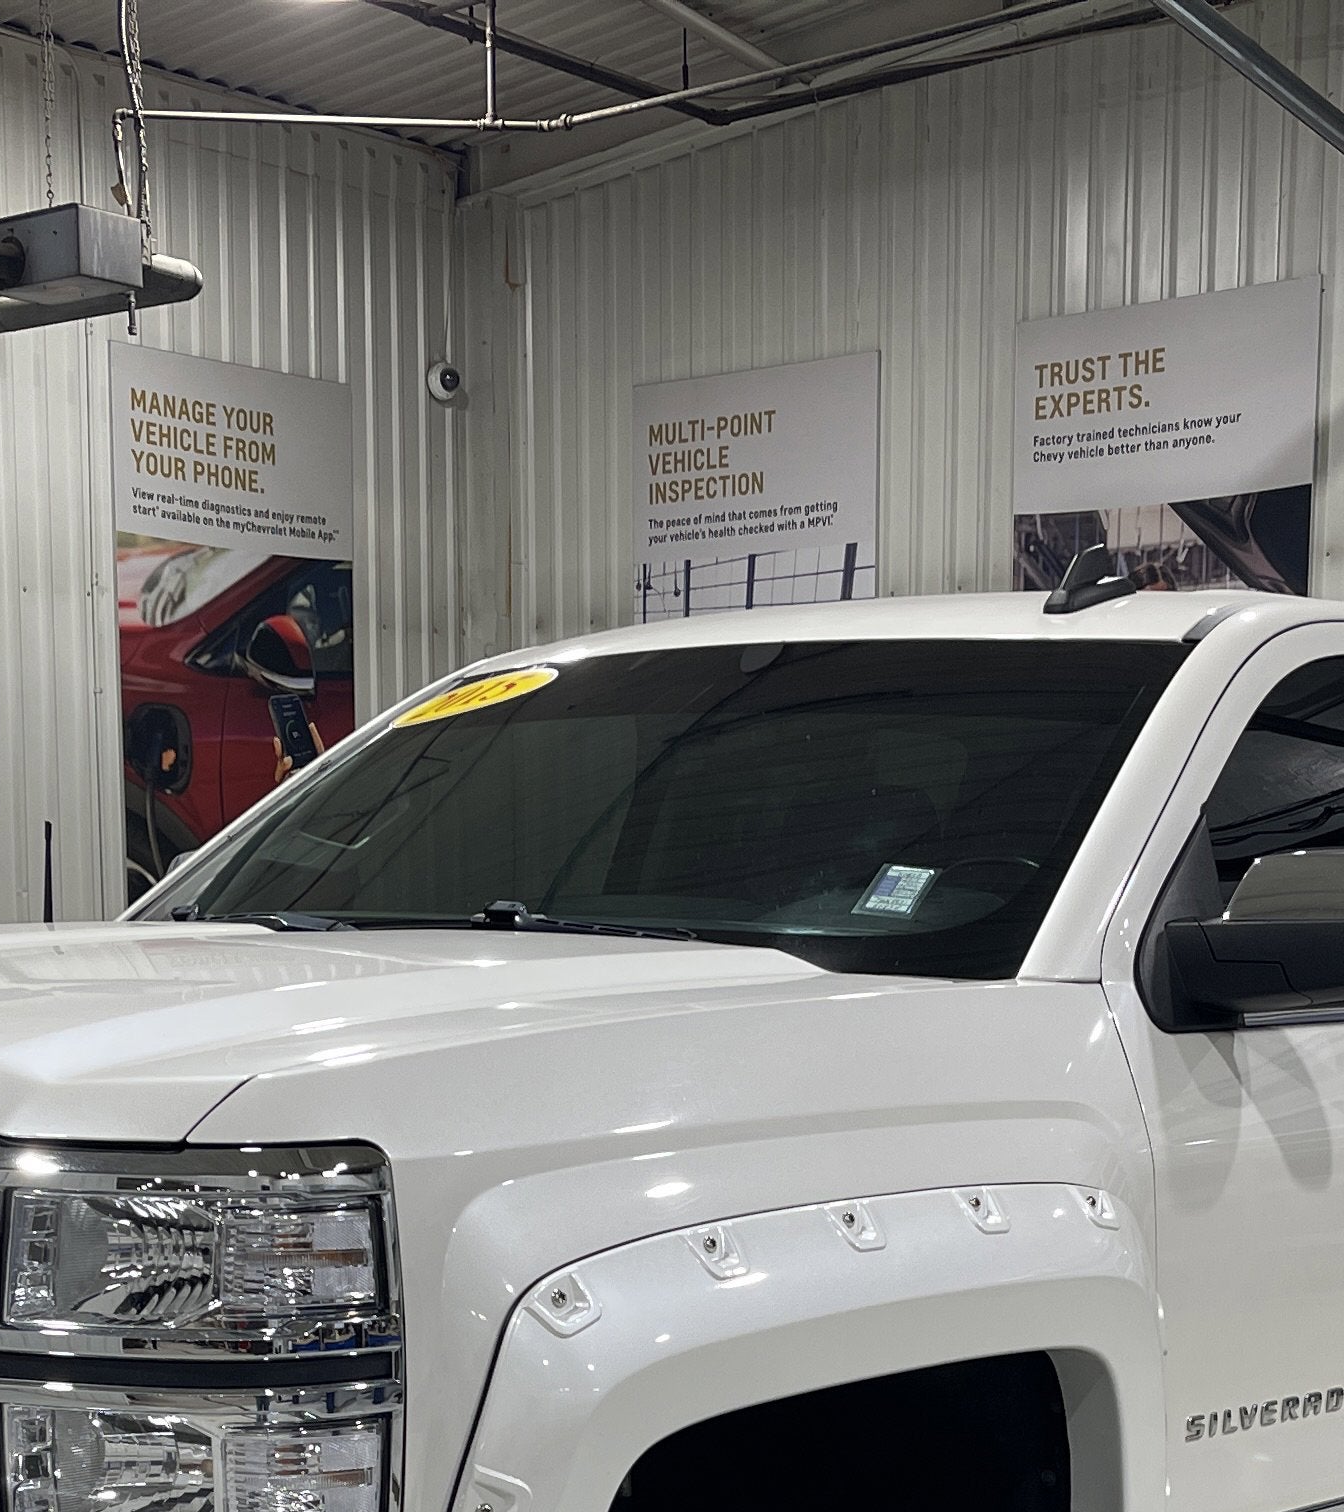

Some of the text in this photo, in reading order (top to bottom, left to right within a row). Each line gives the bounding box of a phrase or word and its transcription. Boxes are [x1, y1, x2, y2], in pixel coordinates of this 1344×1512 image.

[1034, 347, 1166, 389] TRUST THE
[130, 386, 274, 436] MANAGE YOUR
[1034, 383, 1150, 421] EXPERTS.
[130, 418, 276, 466] VEHICLE FROM
[648, 409, 776, 447] MULTI-POINT
[1033, 413, 1241, 447] Factory trained technicians know your
[648, 445, 729, 476] VEHICLE
[1033, 434, 1215, 463] Chevy vehicle better than anyone.
[131, 448, 265, 494] YOUR PHONE.
[649, 471, 764, 506] INSPECTION
[131, 487, 326, 525] View real-time diagnostics and enjoy remote
[648, 500, 838, 531] The peace of mind that comes from getting
[161, 509, 201, 525] available
[203, 516, 214, 526] on
[216, 517, 230, 529] the
[232, 520, 287, 537] myChevrolet
[289, 526, 315, 540] Mobile
[648, 534, 667, 547] your
[669, 528, 706, 542] vehicle's
[708, 525, 736, 539] health
[738, 522, 775, 536] checked
[777, 519, 797, 531] with
[800, 520, 805, 529] a
